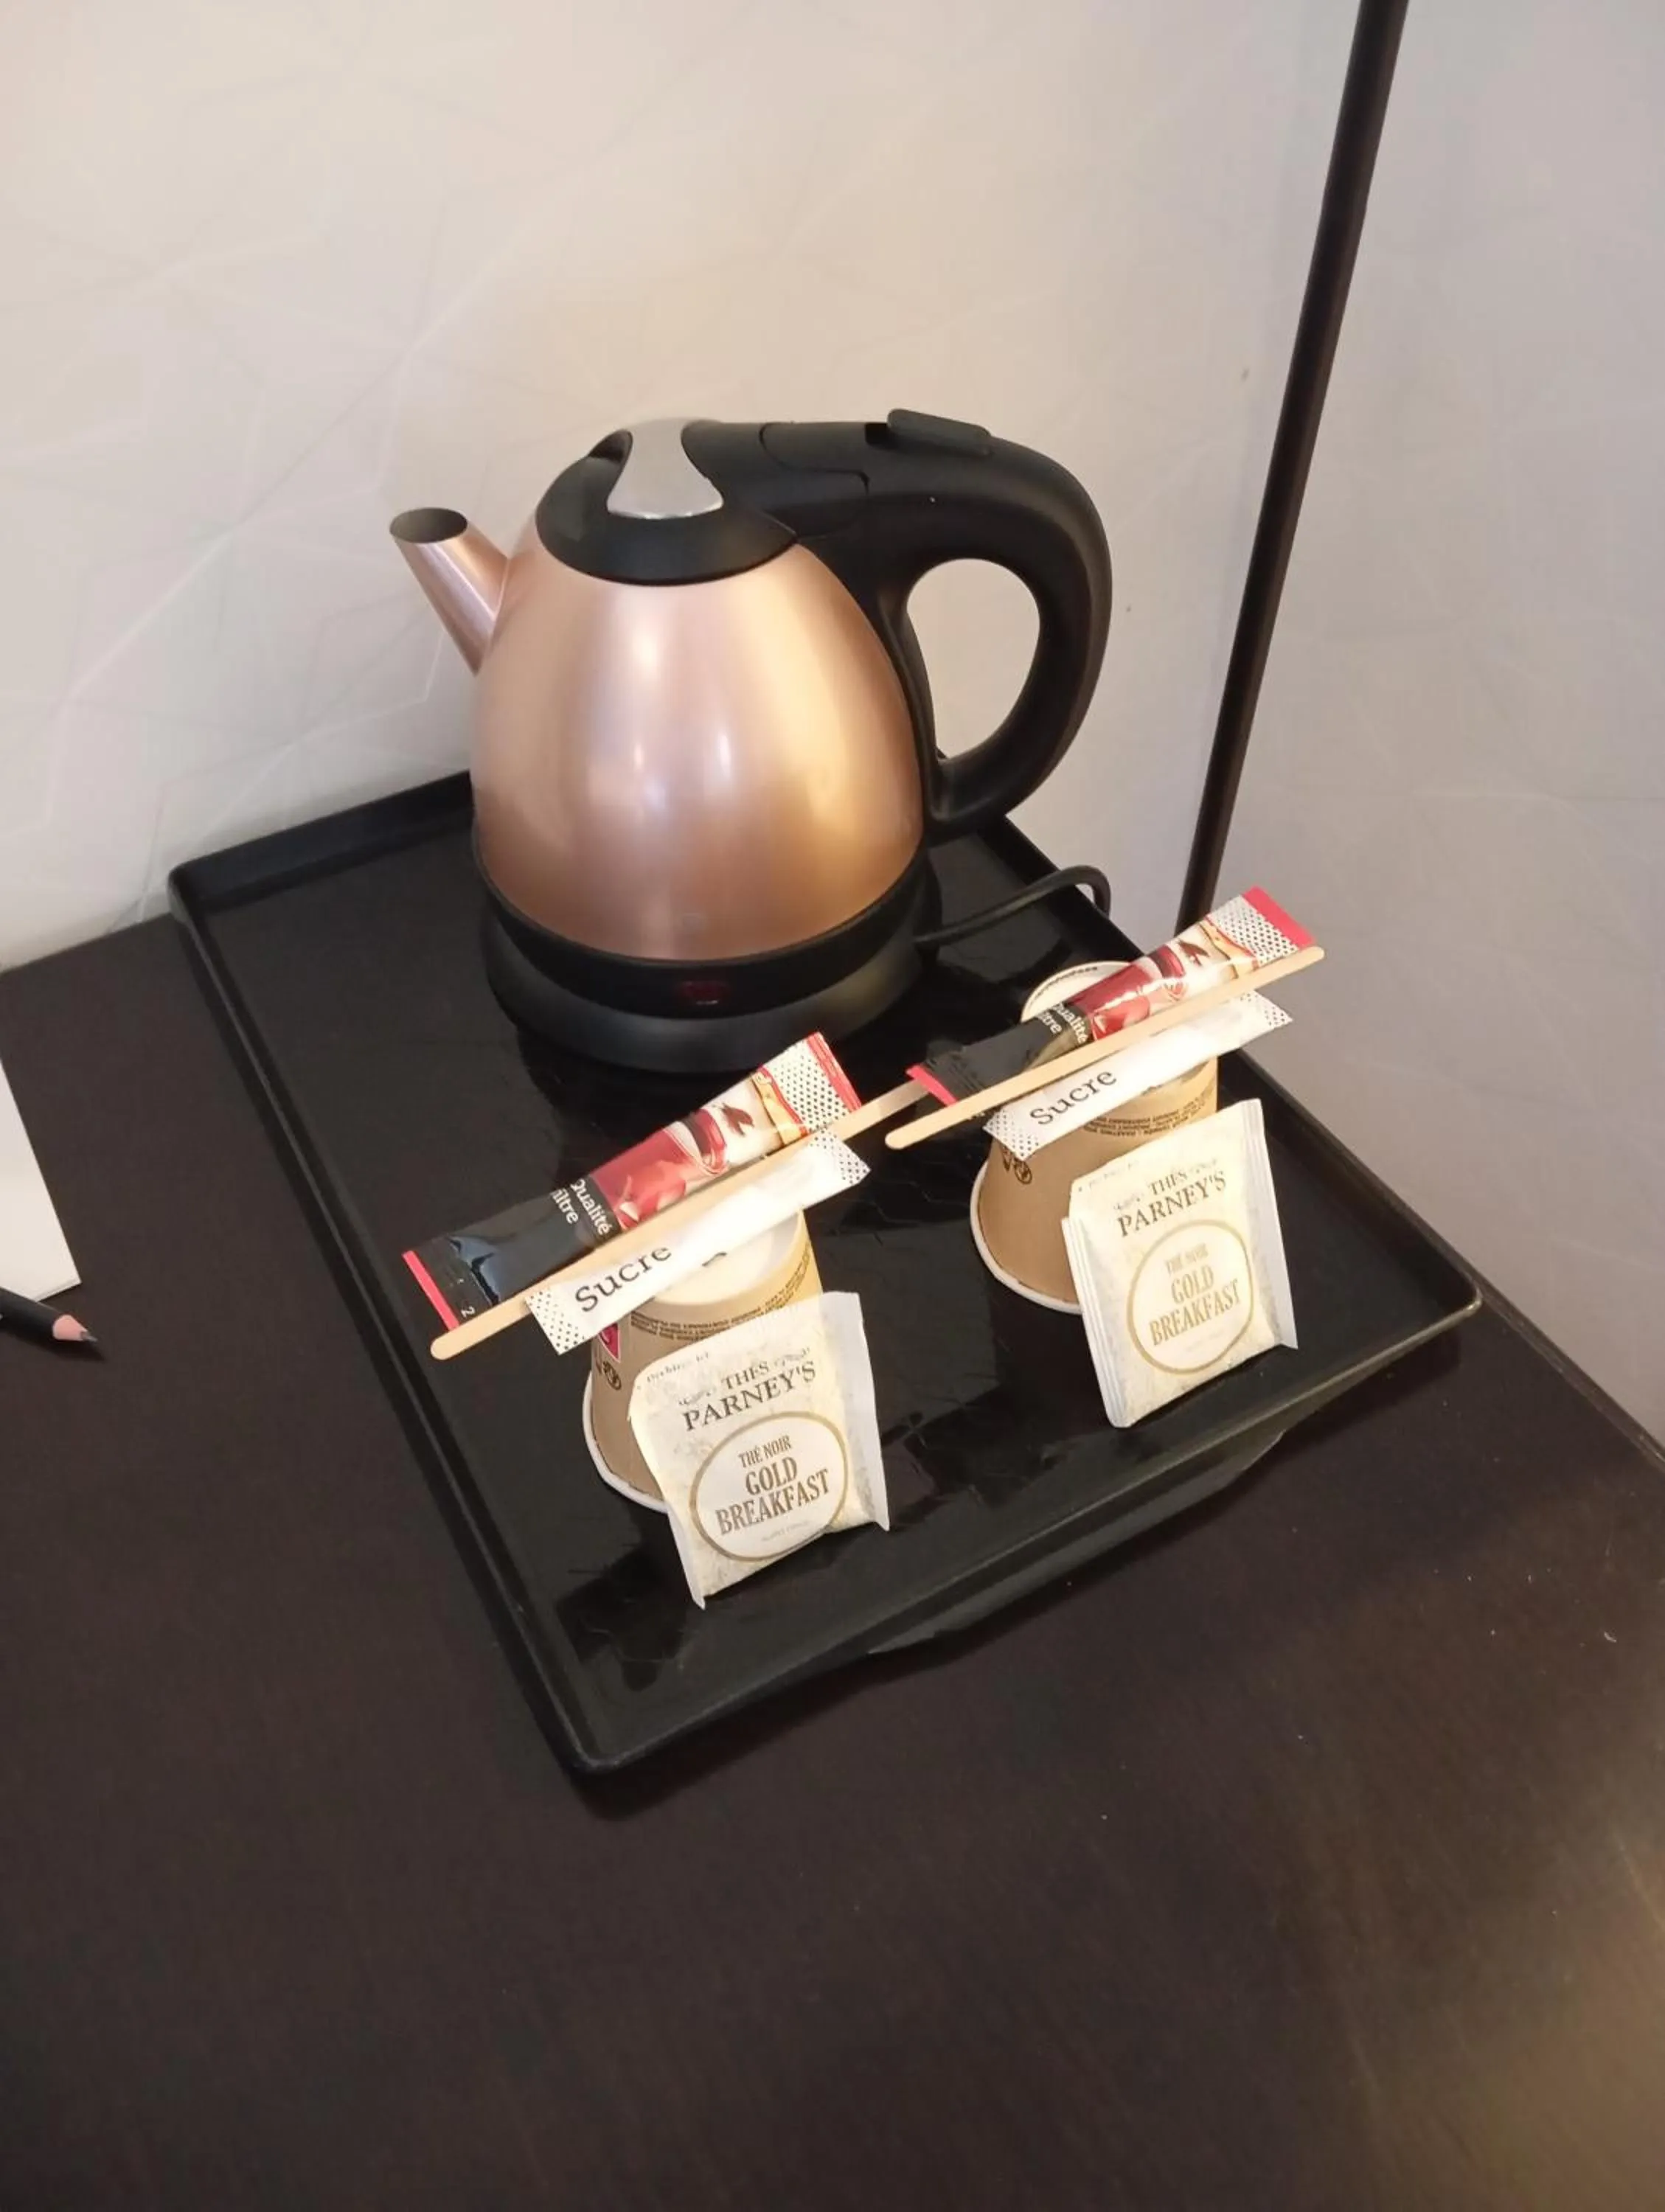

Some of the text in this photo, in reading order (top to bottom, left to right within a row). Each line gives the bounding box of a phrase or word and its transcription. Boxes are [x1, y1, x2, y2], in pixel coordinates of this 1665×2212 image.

[1029, 1071, 1117, 1126] Sucre
[1116, 1170, 1226, 1237] PARNEY'S
[574, 1247, 672, 1312] Sucre
[1149, 1278, 1240, 1346] BREAKFAST
[1171, 1265, 1214, 1304] GOLD
[682, 1360, 816, 1432] PARNEY'S
[745, 1455, 798, 1496] GOLD
[762, 1434, 793, 1460] NOIR
[715, 1468, 830, 1536] BREAKFAST
